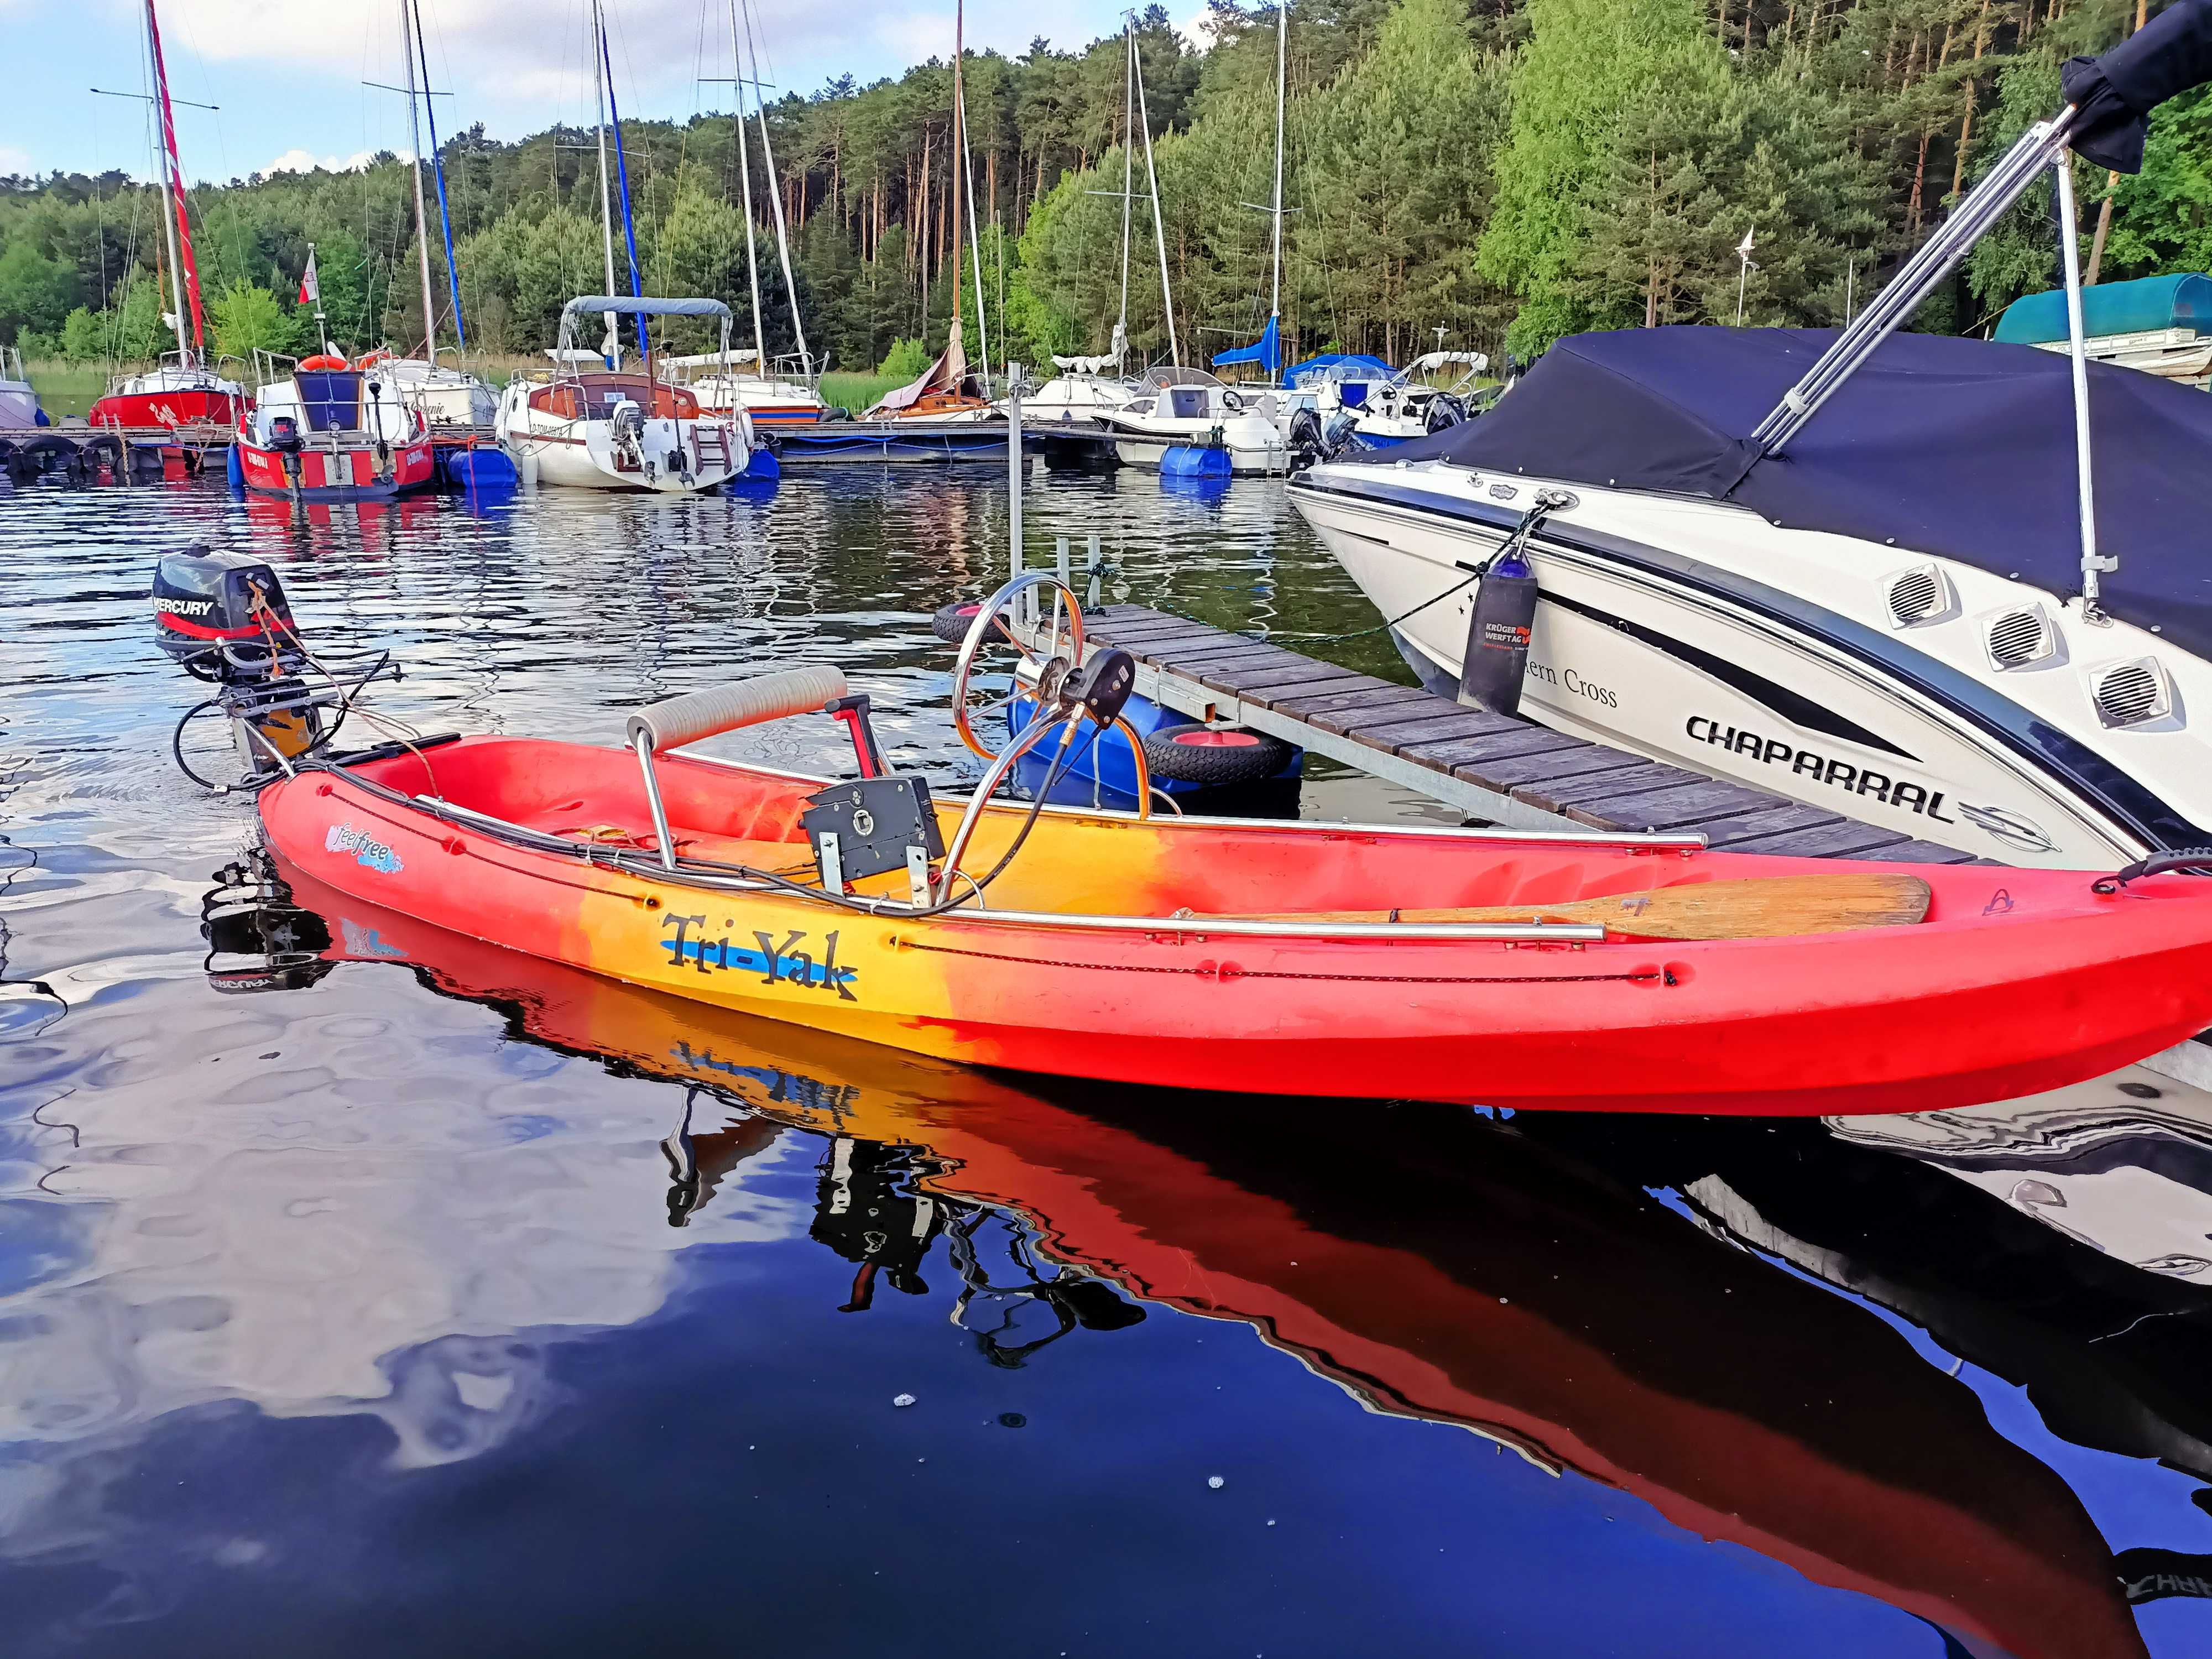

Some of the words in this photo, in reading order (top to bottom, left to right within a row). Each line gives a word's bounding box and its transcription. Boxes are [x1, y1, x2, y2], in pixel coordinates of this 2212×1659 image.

[1564, 669, 1618, 708] Cross
[1686, 716, 1955, 825] CHAPARRAL
[662, 912, 859, 1003] Tri-Yak
